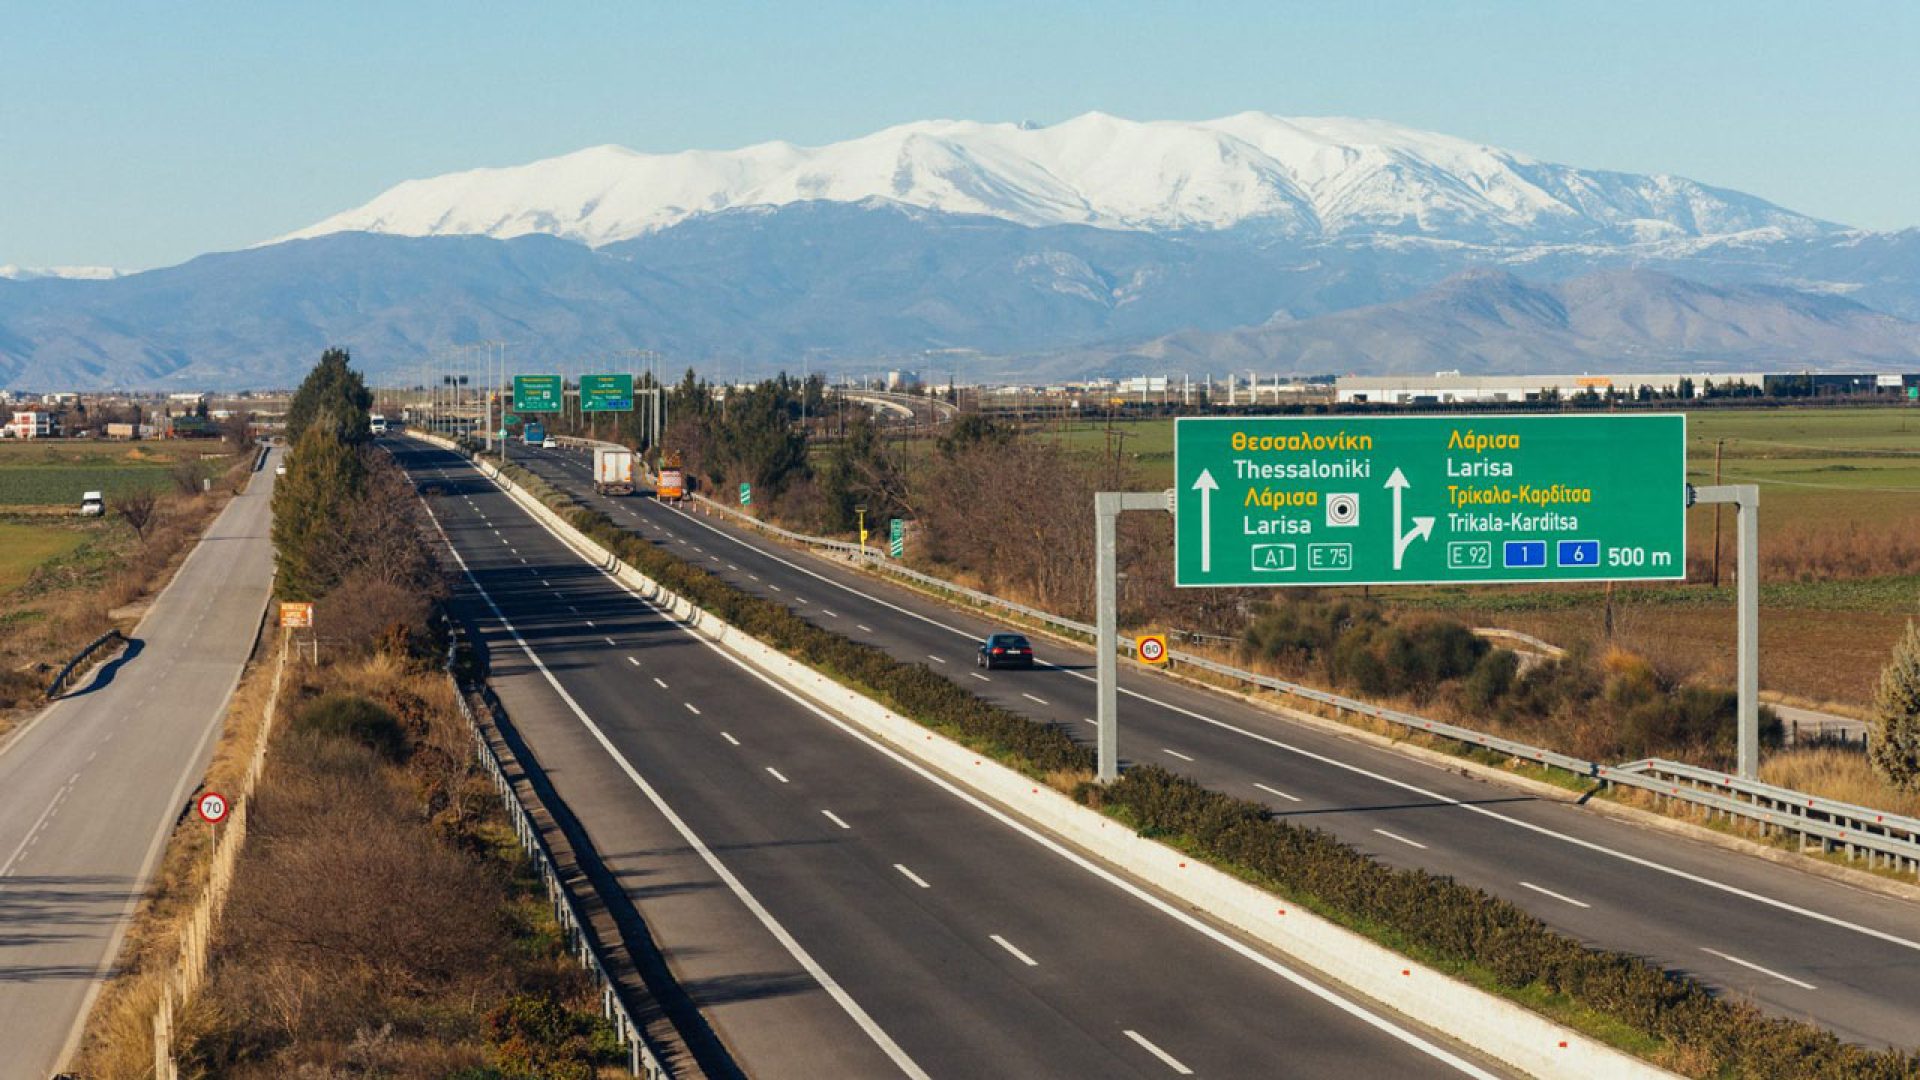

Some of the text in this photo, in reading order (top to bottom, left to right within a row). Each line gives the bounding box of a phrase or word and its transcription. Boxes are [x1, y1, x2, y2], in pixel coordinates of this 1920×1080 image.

[1231, 430, 1372, 451] Θεσσαλονίκη
[1447, 429, 1520, 453] Λάρισα
[1233, 458, 1370, 479] Thessaloniki
[1447, 457, 1513, 477] Larisa
[1244, 486, 1318, 511] Λάρισα
[1447, 484, 1591, 508] Τρίκαλα-Καρδίτσα
[1244, 515, 1311, 535] Larisa
[1448, 512, 1578, 532] Trikala-Karditsa
[1265, 549, 1284, 566] A1
[1313, 548, 1348, 565] E 75
[1453, 547, 1487, 563] E 92
[1521, 546, 1528, 562] 1
[1574, 545, 1584, 562] 6
[1608, 547, 1672, 566] 500 m
[204, 802, 221, 813] 70
